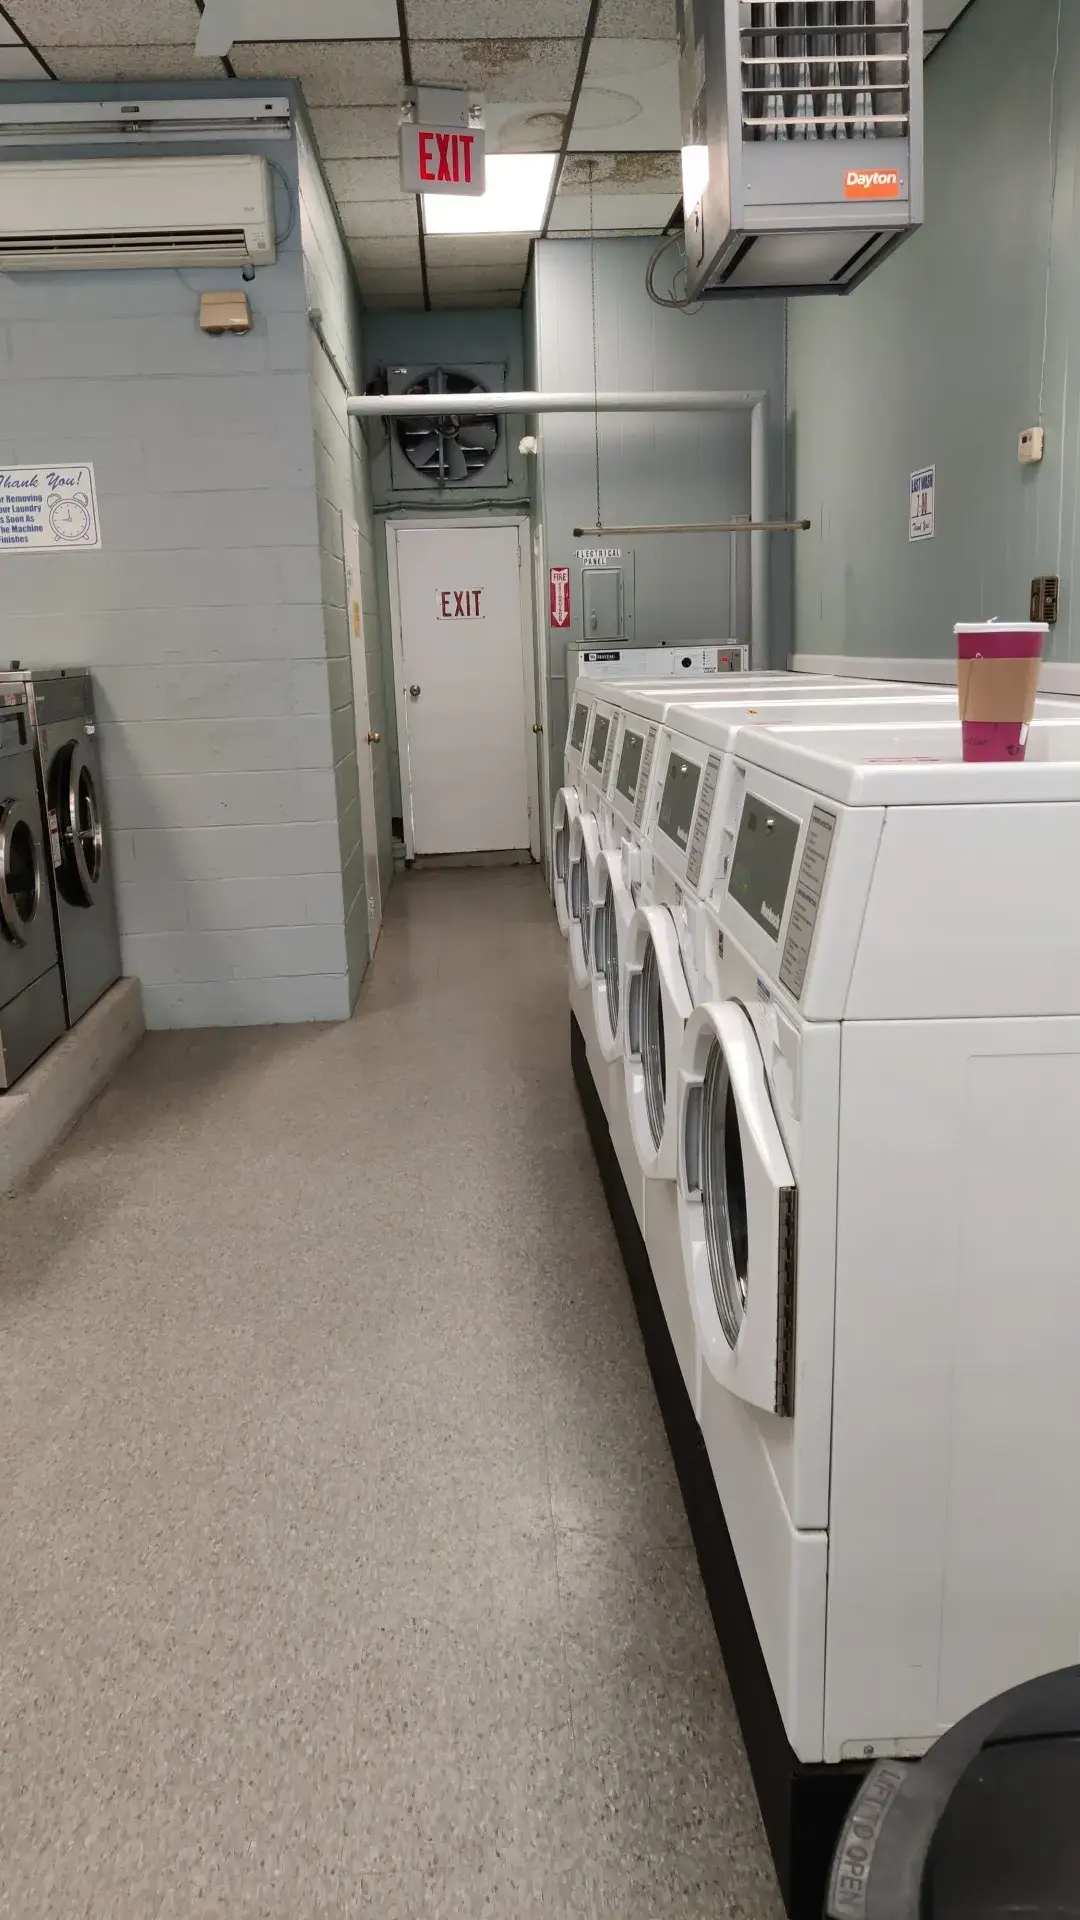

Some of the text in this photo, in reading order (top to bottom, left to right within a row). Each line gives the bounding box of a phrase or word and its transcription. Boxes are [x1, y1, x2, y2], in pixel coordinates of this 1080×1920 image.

[419, 132, 473, 182] EXIT
[847, 172, 896, 188] Dayton
[46, 472, 82, 491] You!
[912, 478, 920, 493] LAST
[6, 494, 42, 503] Removing
[12, 505, 41, 513] Laundry
[12, 525, 43, 533] Machine
[576, 549, 620, 558] ELECTRICAL
[553, 573, 566, 581] FIRE
[441, 591, 482, 617] EXIT
[839, 1768, 900, 1906] LIFT TO OPEN
